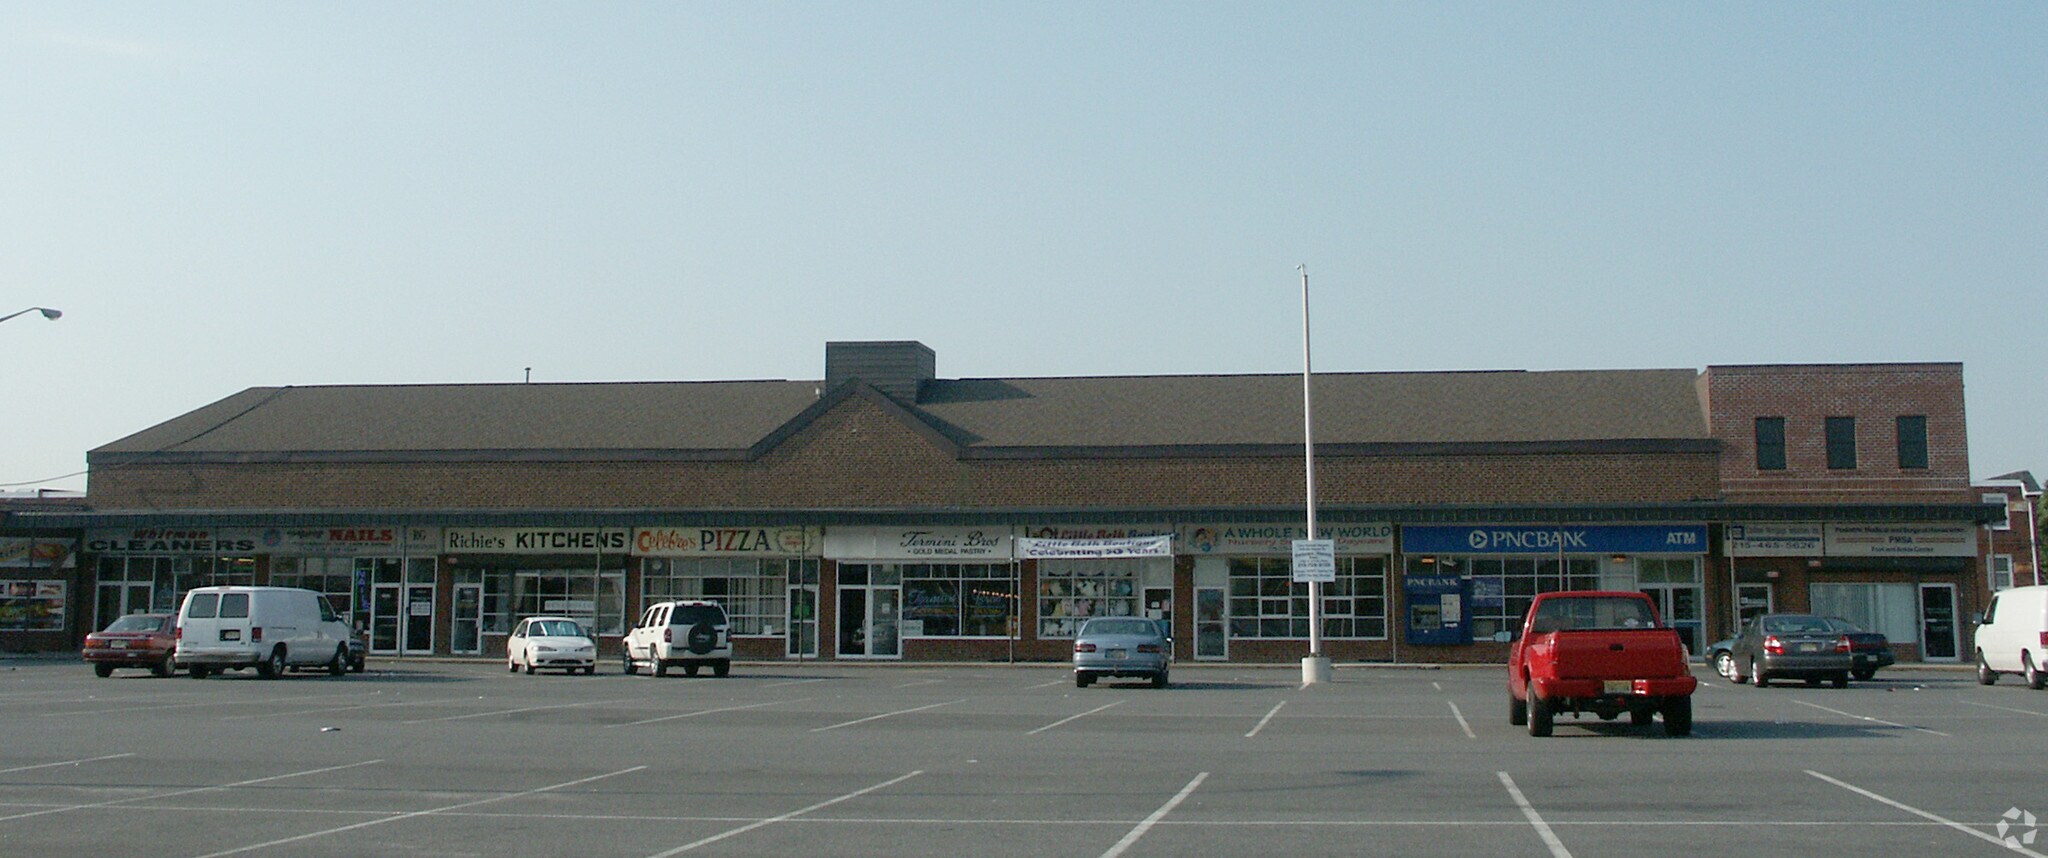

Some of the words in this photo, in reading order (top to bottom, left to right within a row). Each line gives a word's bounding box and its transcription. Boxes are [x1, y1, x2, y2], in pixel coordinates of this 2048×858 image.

[328, 529, 392, 541] NAILS
[900, 530, 958, 547] Termini
[963, 530, 1000, 547] Bros
[1224, 527, 1236, 538] A
[1235, 527, 1292, 538] WHOLE
[1338, 526, 1392, 538] WORLD
[1491, 531, 1587, 547] PNCBANK
[1665, 531, 1696, 545] ATM
[88, 540, 255, 551] CLEANERS
[449, 532, 506, 549] Richie's
[516, 532, 624, 548] KITCHENS
[699, 529, 772, 551] PIZZA
[1407, 578, 1458, 586] PNCBANK
